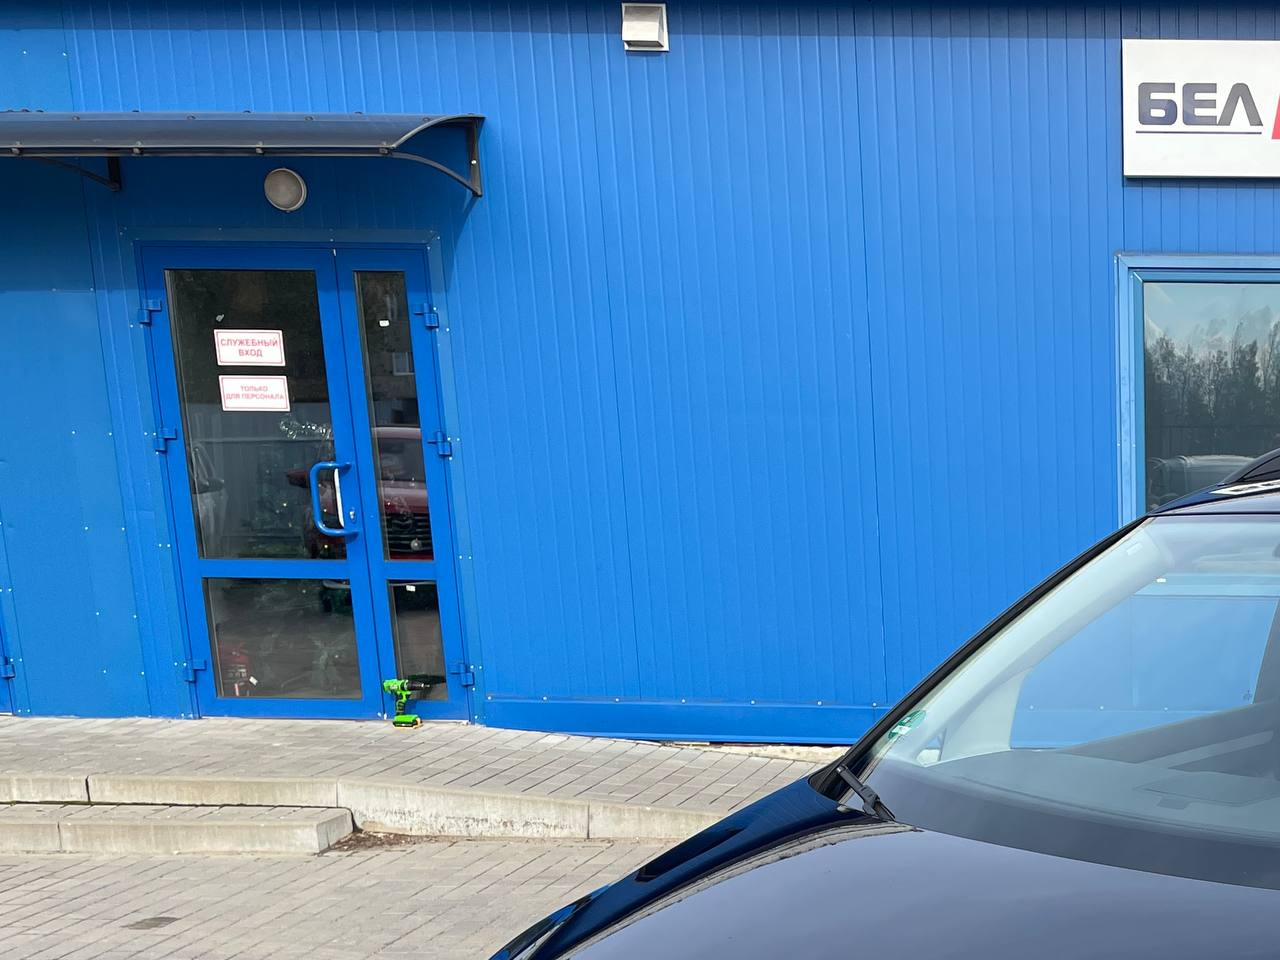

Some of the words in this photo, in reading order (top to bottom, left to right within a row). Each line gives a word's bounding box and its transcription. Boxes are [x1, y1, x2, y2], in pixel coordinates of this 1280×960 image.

[1138, 82, 1263, 126] БЕЛ
[220, 337, 278, 347] СЛУЖЕБНЫЙ
[238, 349, 263, 357] ВХОД
